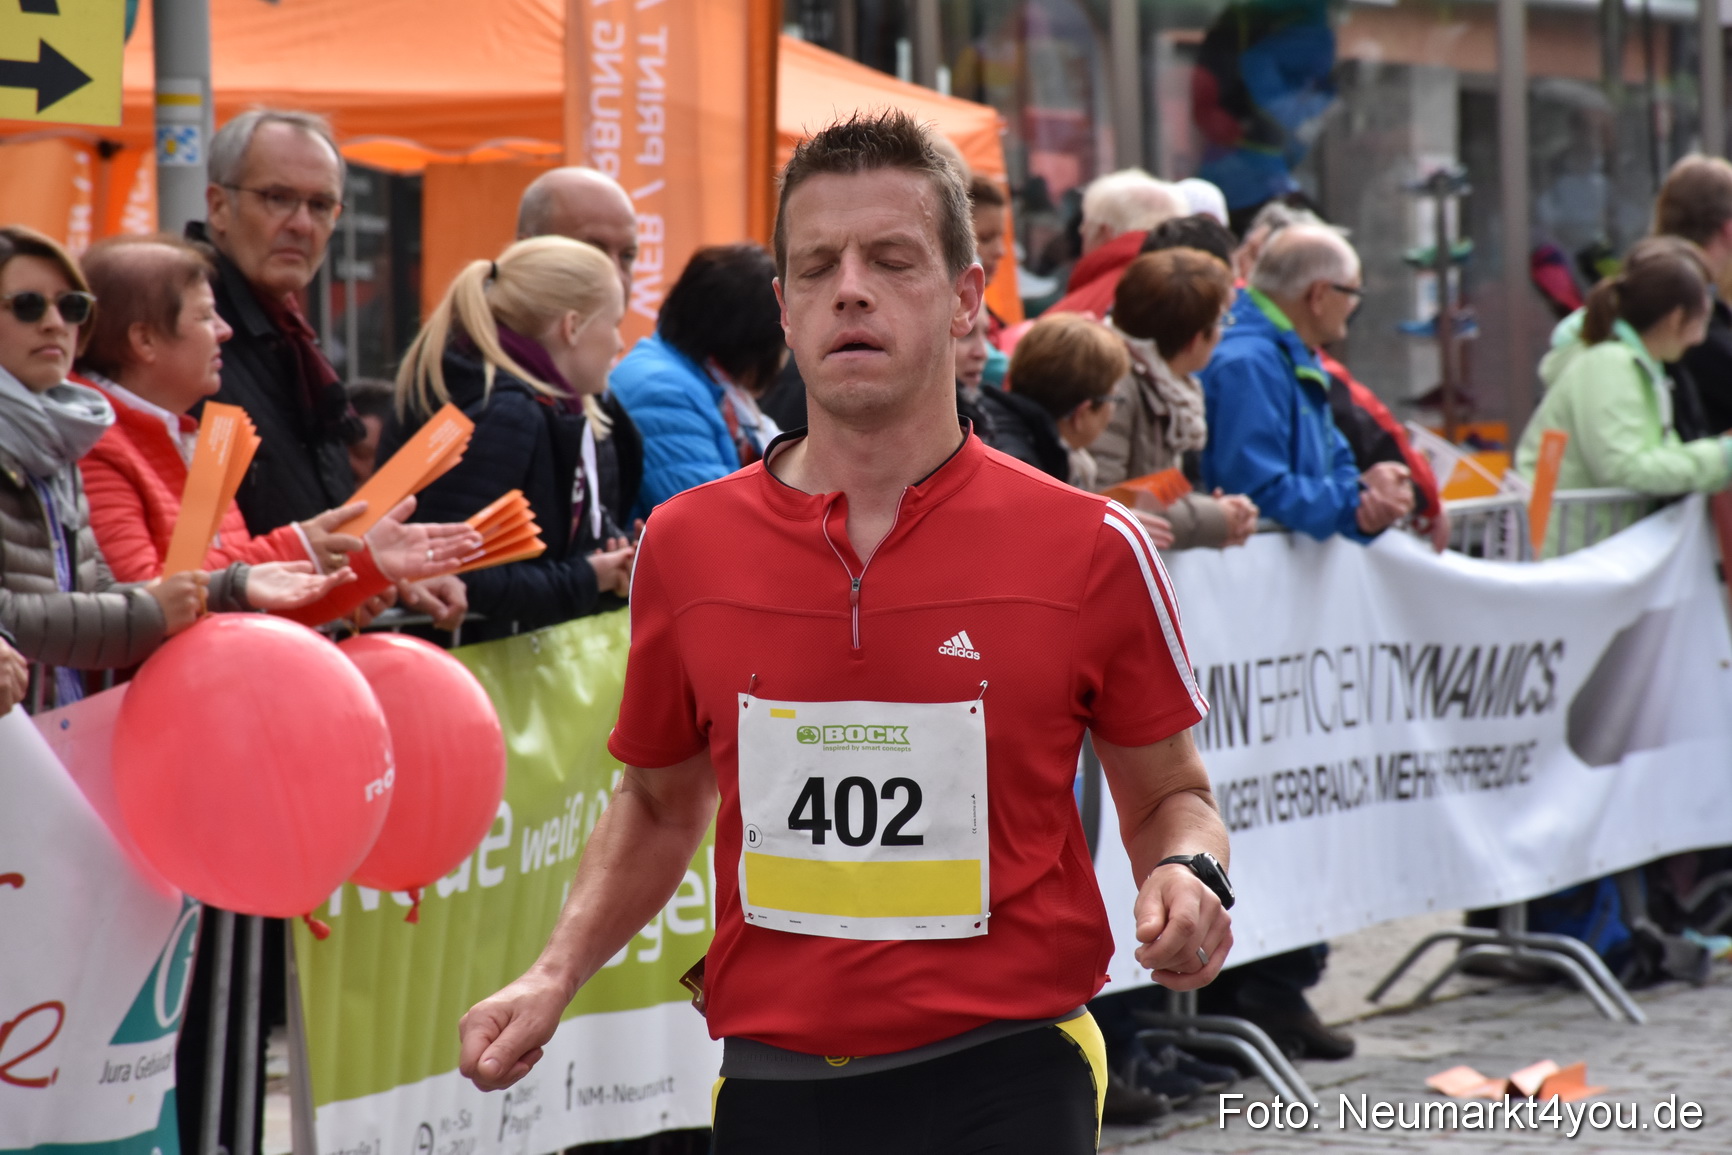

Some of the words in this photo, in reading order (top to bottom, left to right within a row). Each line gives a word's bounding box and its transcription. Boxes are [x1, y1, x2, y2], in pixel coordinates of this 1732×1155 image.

[938, 646, 981, 660] adidas
[1194, 659, 1251, 752] MW
[823, 725, 910, 744] BOCK
[823, 744, 850, 752] inspired
[851, 744, 860, 752] by
[787, 775, 924, 848] 402
[749, 829, 757, 843] D
[98, 1059, 131, 1085] Jura
[577, 1075, 675, 1108] NM-Neumkt
